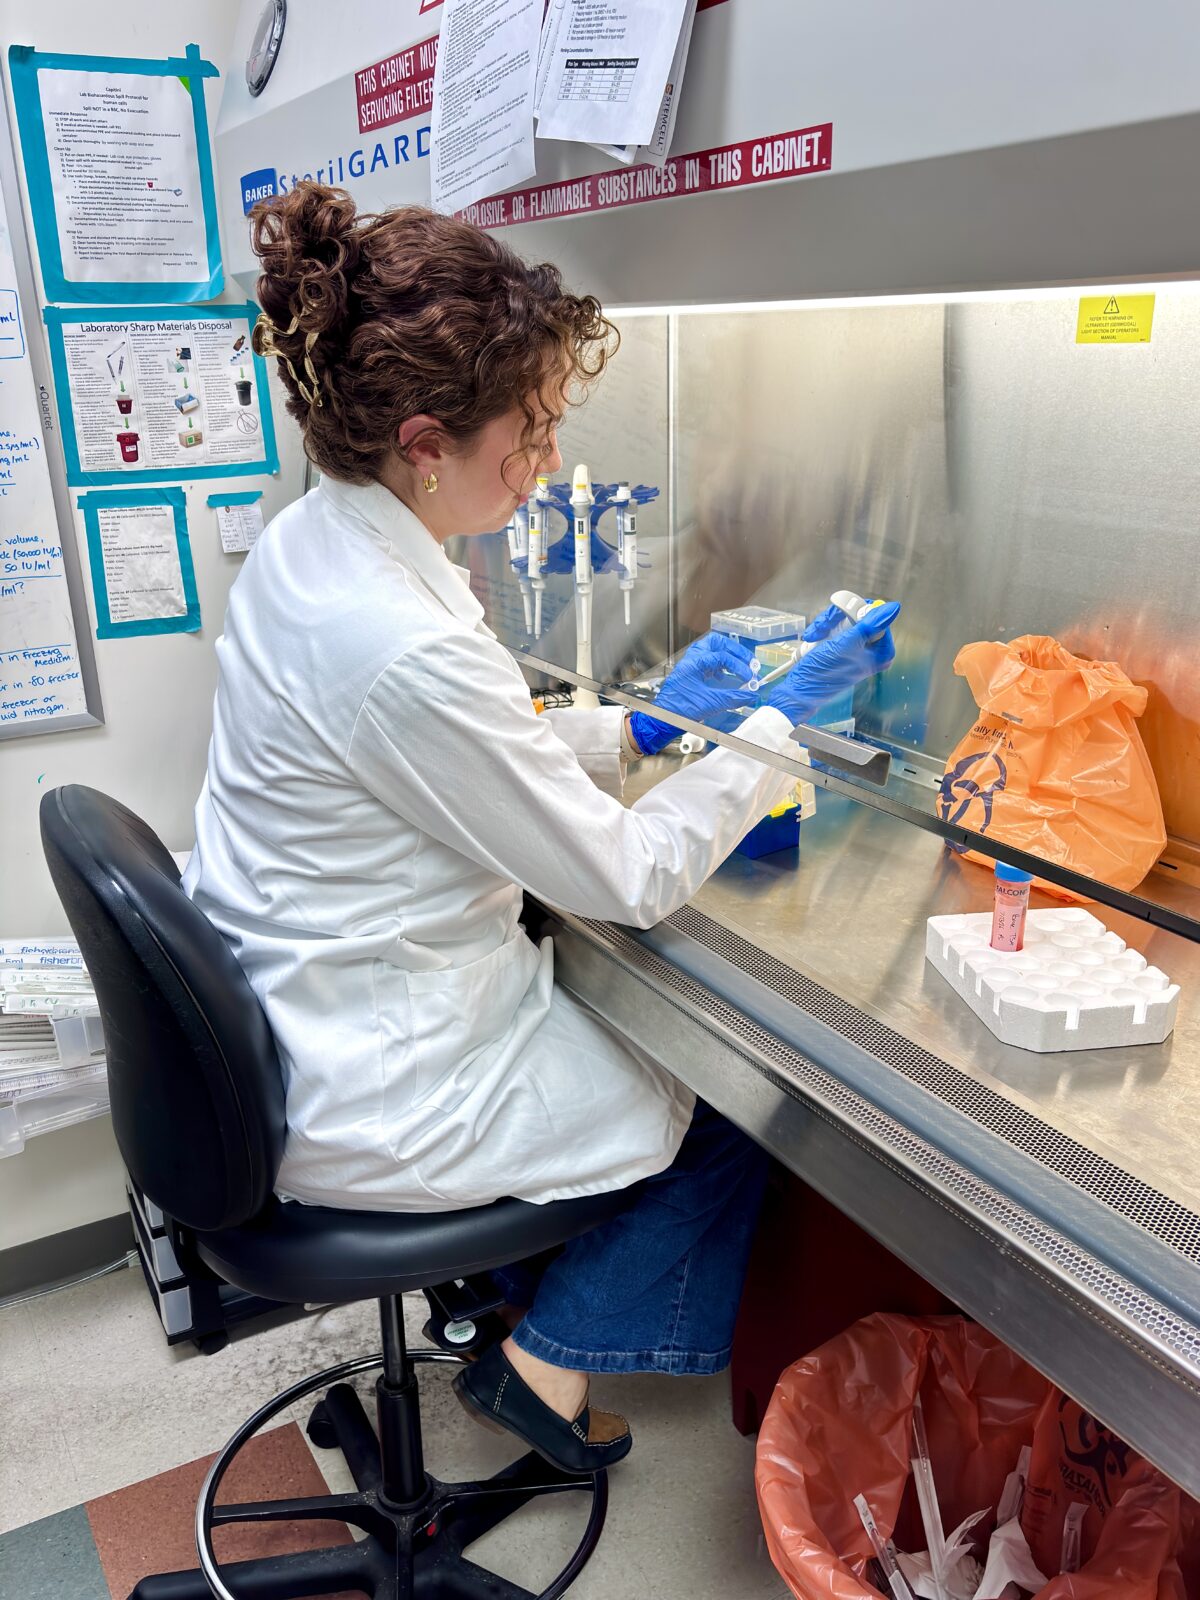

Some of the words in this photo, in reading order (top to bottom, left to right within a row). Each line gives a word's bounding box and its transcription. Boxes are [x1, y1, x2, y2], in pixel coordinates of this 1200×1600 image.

[357, 68, 377, 96] THIS
[380, 50, 415, 88] CABINET
[360, 89, 404, 127] SERVICING
[657, 96, 672, 147] STEMCELL
[244, 183, 274, 203] BAKER
[461, 199, 508, 226] EXPLOSIVE,
[512, 196, 526, 220] OR
[530, 181, 592, 217] FLAMMABLE
[597, 162, 677, 206] SUBSTANCES
[685, 157, 700, 190] IN
[708, 148, 743, 185] THIS
[751, 131, 827, 177] CABINET.
[80, 323, 128, 333] Laboratory
[130, 322, 155, 332] Sharp
[157, 322, 197, 331] Materials
[198, 320, 232, 330] Disposal
[40, 391, 53, 431] Quartet
[5, 534, 44, 545] volume,
[43, 695, 56, 703] or
